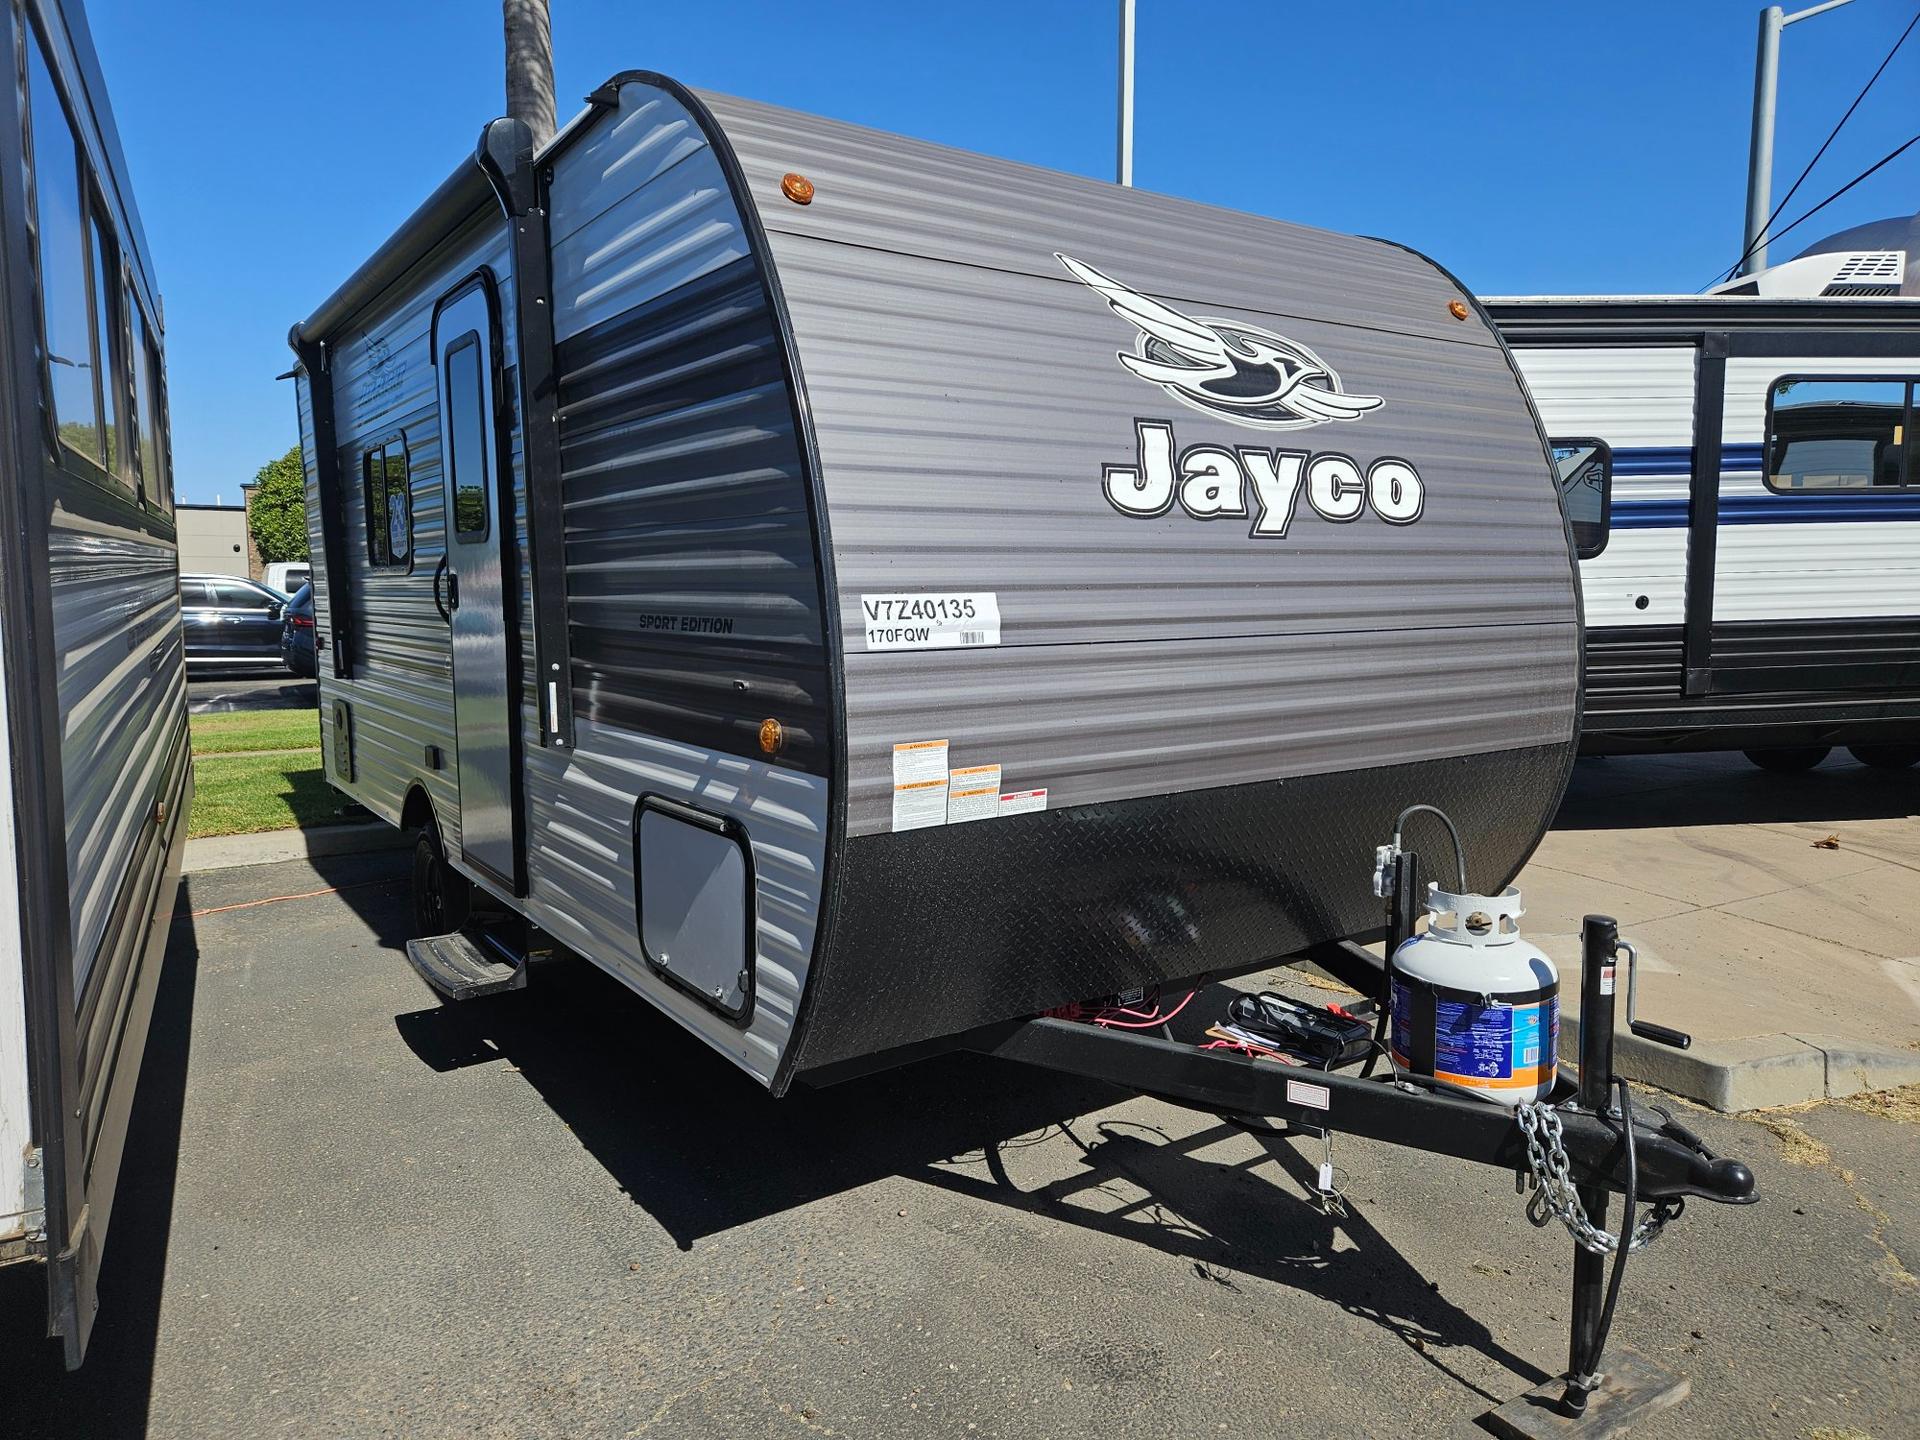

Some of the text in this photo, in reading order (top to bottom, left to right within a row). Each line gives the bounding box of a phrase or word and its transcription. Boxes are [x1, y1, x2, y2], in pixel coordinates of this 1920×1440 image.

[1101, 417, 1425, 539] Jayco
[863, 598, 976, 621] V7Z40135
[639, 614, 734, 634] SPORT EDITION
[868, 627, 930, 643] 170FQW
